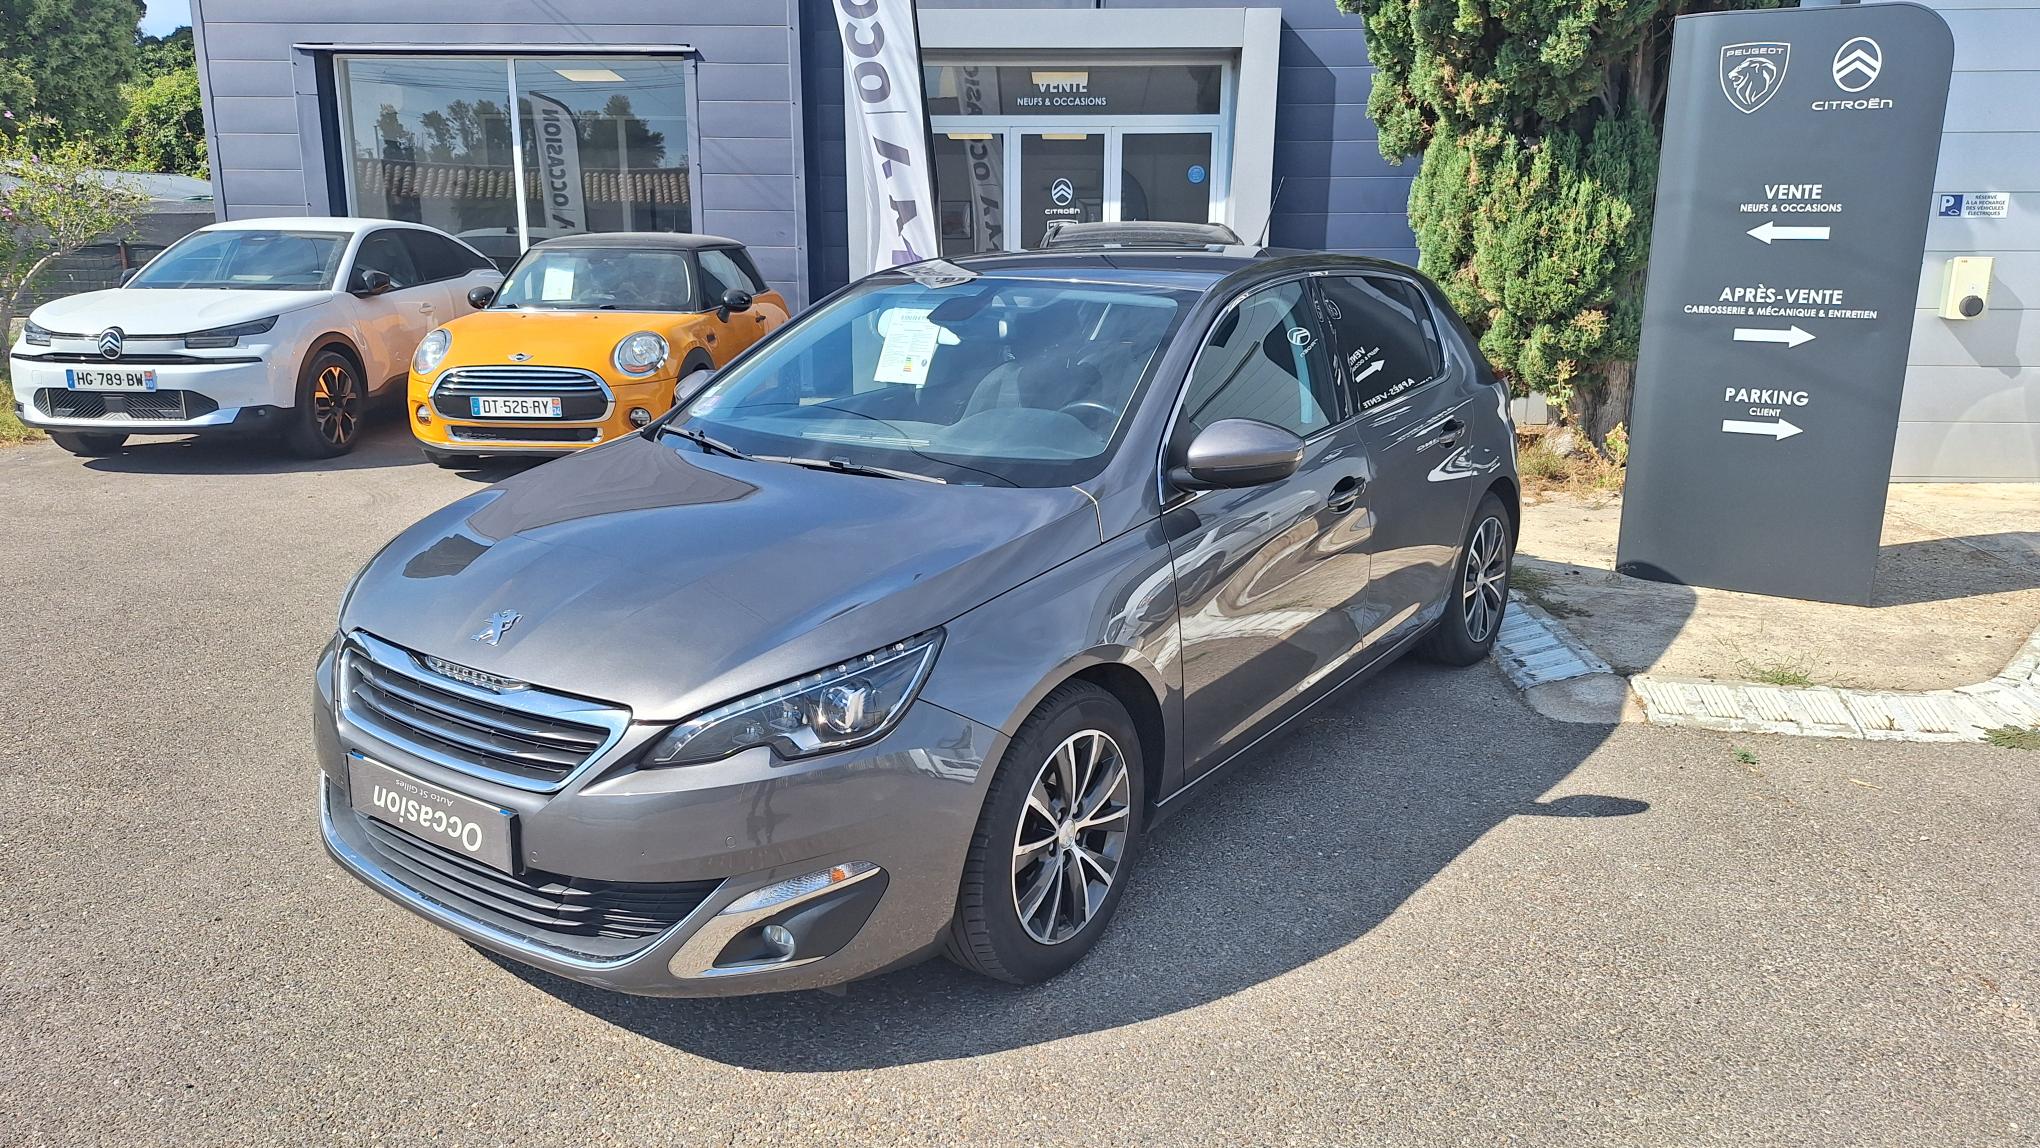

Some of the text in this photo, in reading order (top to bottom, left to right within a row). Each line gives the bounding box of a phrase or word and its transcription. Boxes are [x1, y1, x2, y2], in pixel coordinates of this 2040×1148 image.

[1726, 47, 1784, 58] PEUGEOT
[1017, 97, 1107, 106] NEUFS & OCCASIONS
[1764, 184, 1823, 200] VENTE
[1740, 203, 1843, 213] NEUFS & OCCASIONS
[1718, 284, 1843, 304] APRÈS-VENTE
[1683, 304, 1878, 319] CARROSSERIE & MÉCANIQUE & ENTRETIEN
[1724, 387, 1809, 406] PARKING
[1748, 407, 1781, 417] CLIENT
[395, 778, 455, 807] Auto St Gilles
[372, 784, 484, 853] Occasion
